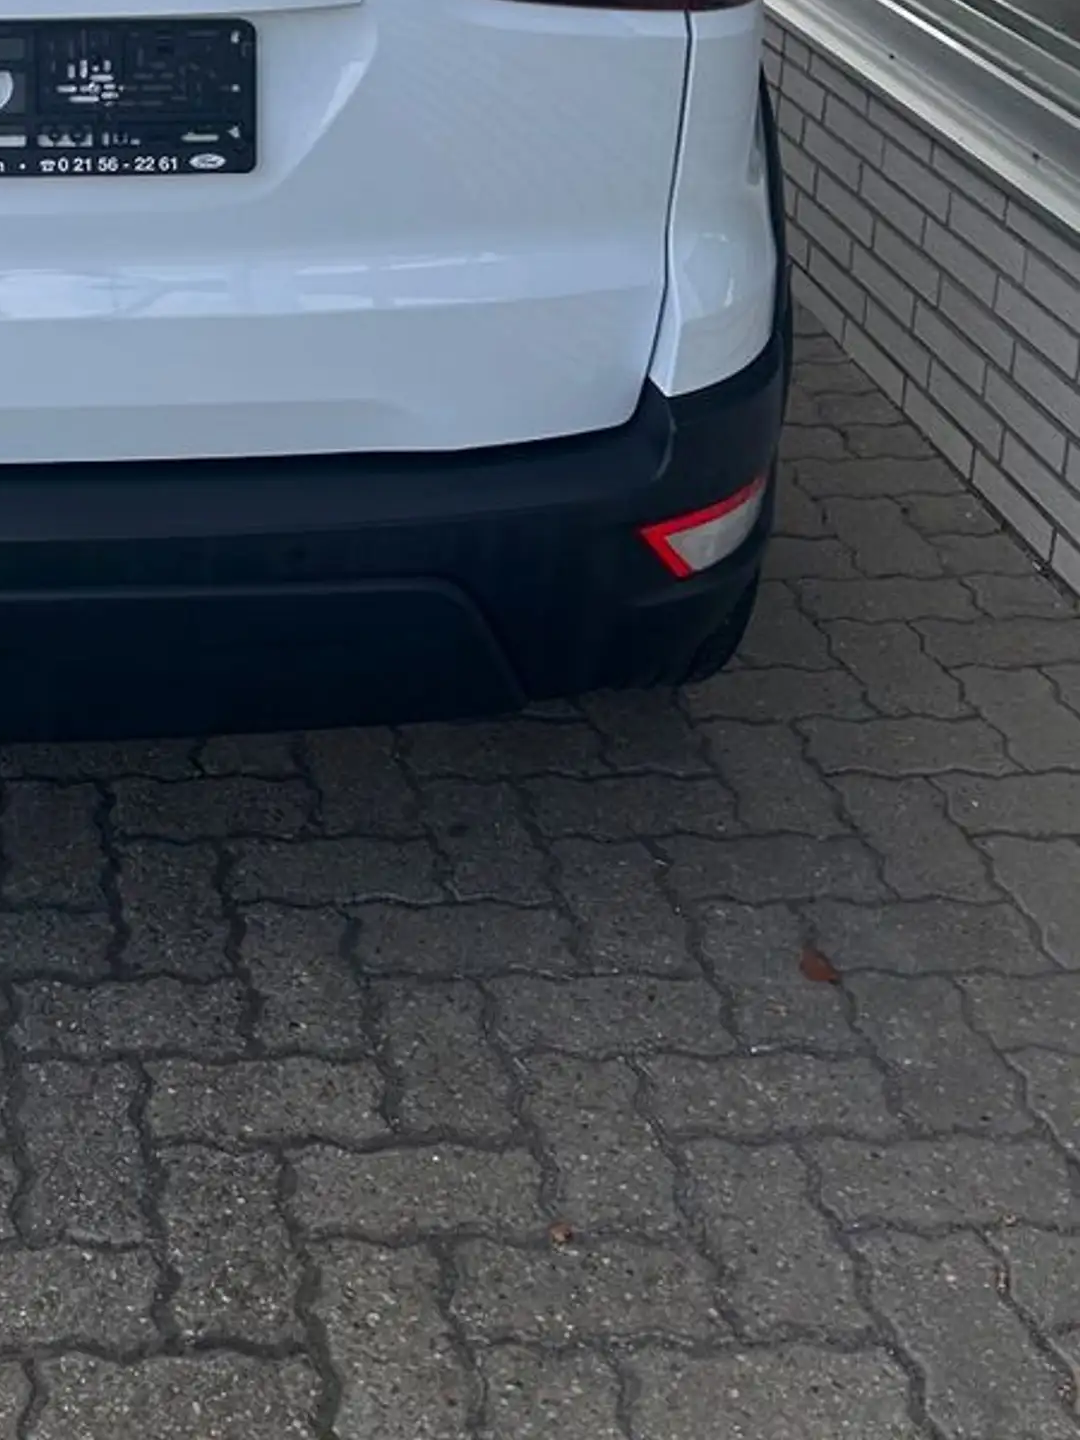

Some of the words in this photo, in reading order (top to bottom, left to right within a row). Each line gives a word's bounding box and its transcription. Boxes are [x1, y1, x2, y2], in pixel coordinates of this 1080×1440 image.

[73, 157, 91, 172] 21
[135, 156, 154, 172] 22
[159, 156, 178, 171] 61
